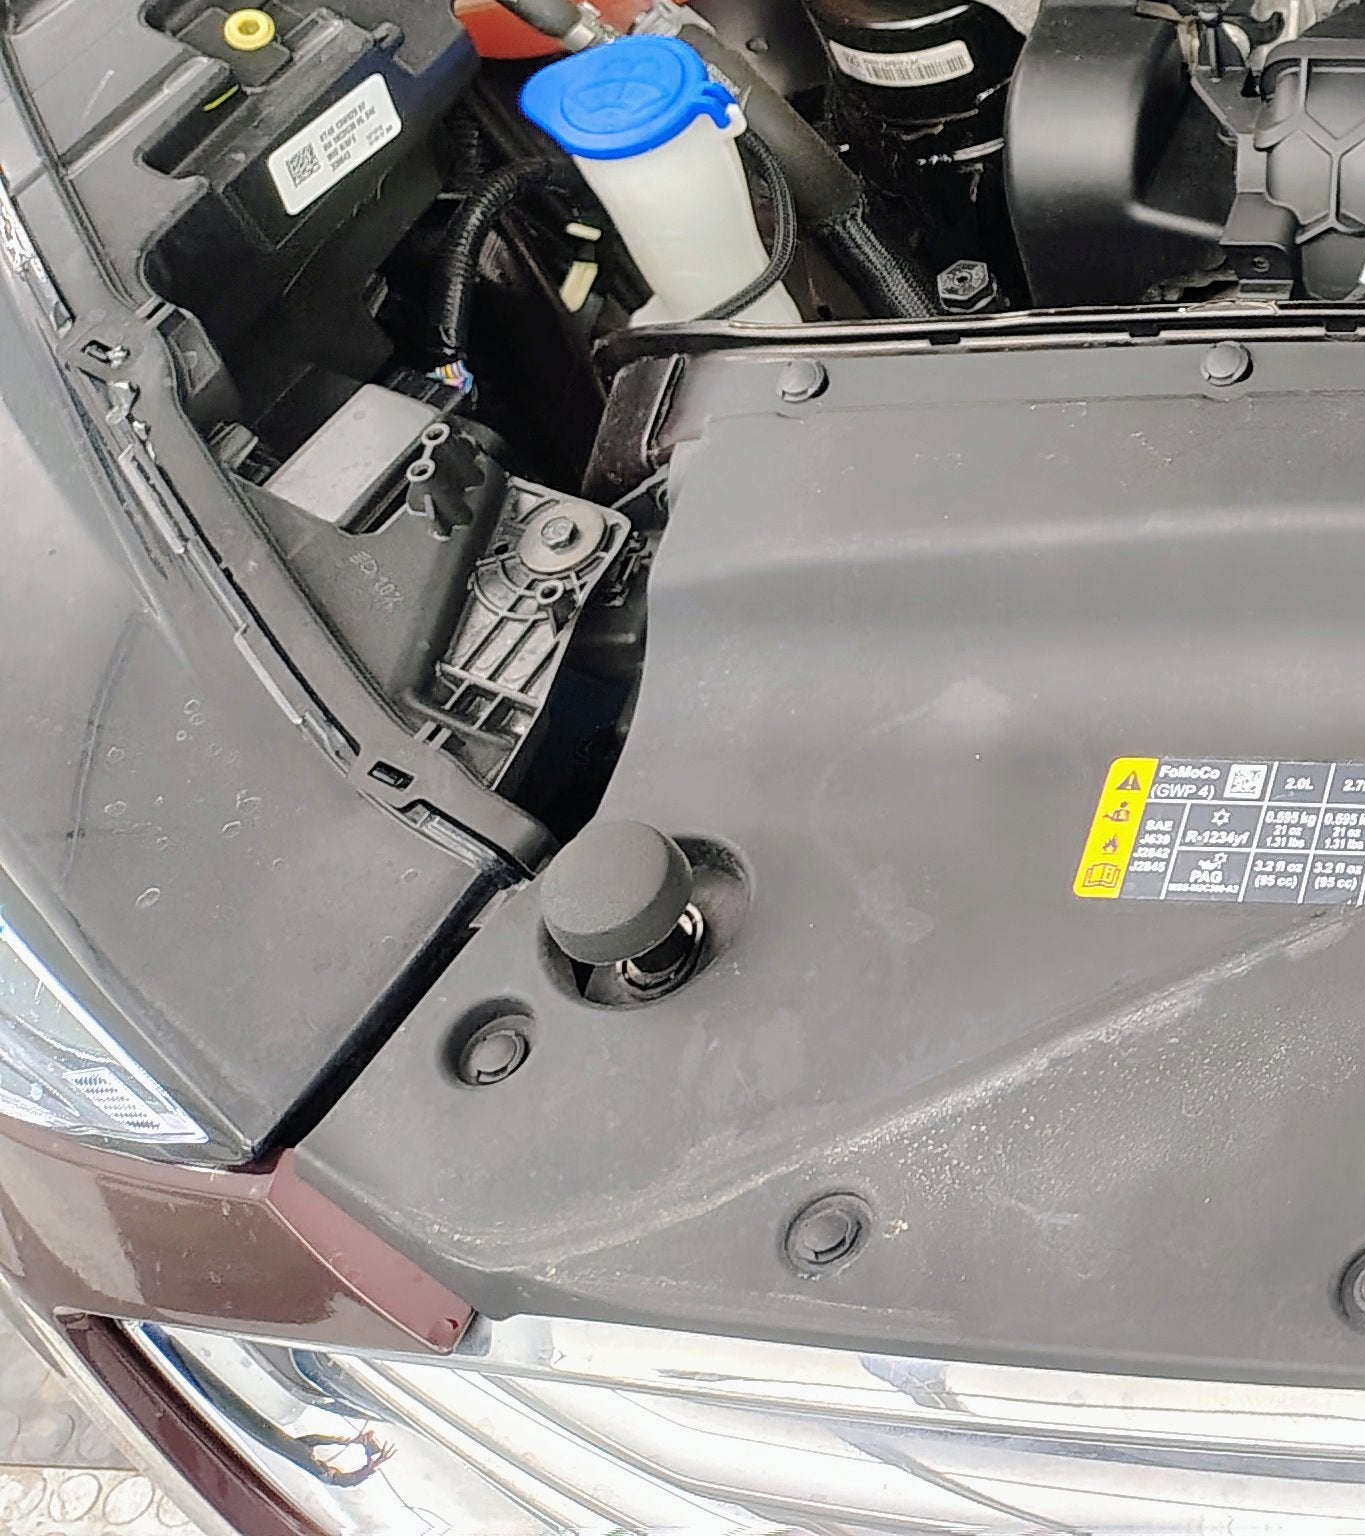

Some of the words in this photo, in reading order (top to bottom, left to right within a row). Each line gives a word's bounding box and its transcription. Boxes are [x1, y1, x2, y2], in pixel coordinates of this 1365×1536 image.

[1157, 766, 1221, 779] FoMoCo
[1284, 777, 1315, 790] 2.0L
[1149, 783, 1197, 799] (GWP
[1195, 784, 1217, 800] 4)
[1144, 818, 1174, 831] SAE
[1298, 811, 1318, 827] kg
[1273, 825, 1287, 835] 21
[1287, 825, 1303, 835] oz
[1332, 826, 1346, 837] 21
[1346, 827, 1362, 837] oz
[1183, 830, 1250, 846] R-1234yf
[1286, 861, 1304, 873] oz
[1346, 862, 1363, 875] oz
[1188, 870, 1223, 883] PAG
[1275, 875, 1298, 889] cc)
[1335, 877, 1358, 891] cc)
